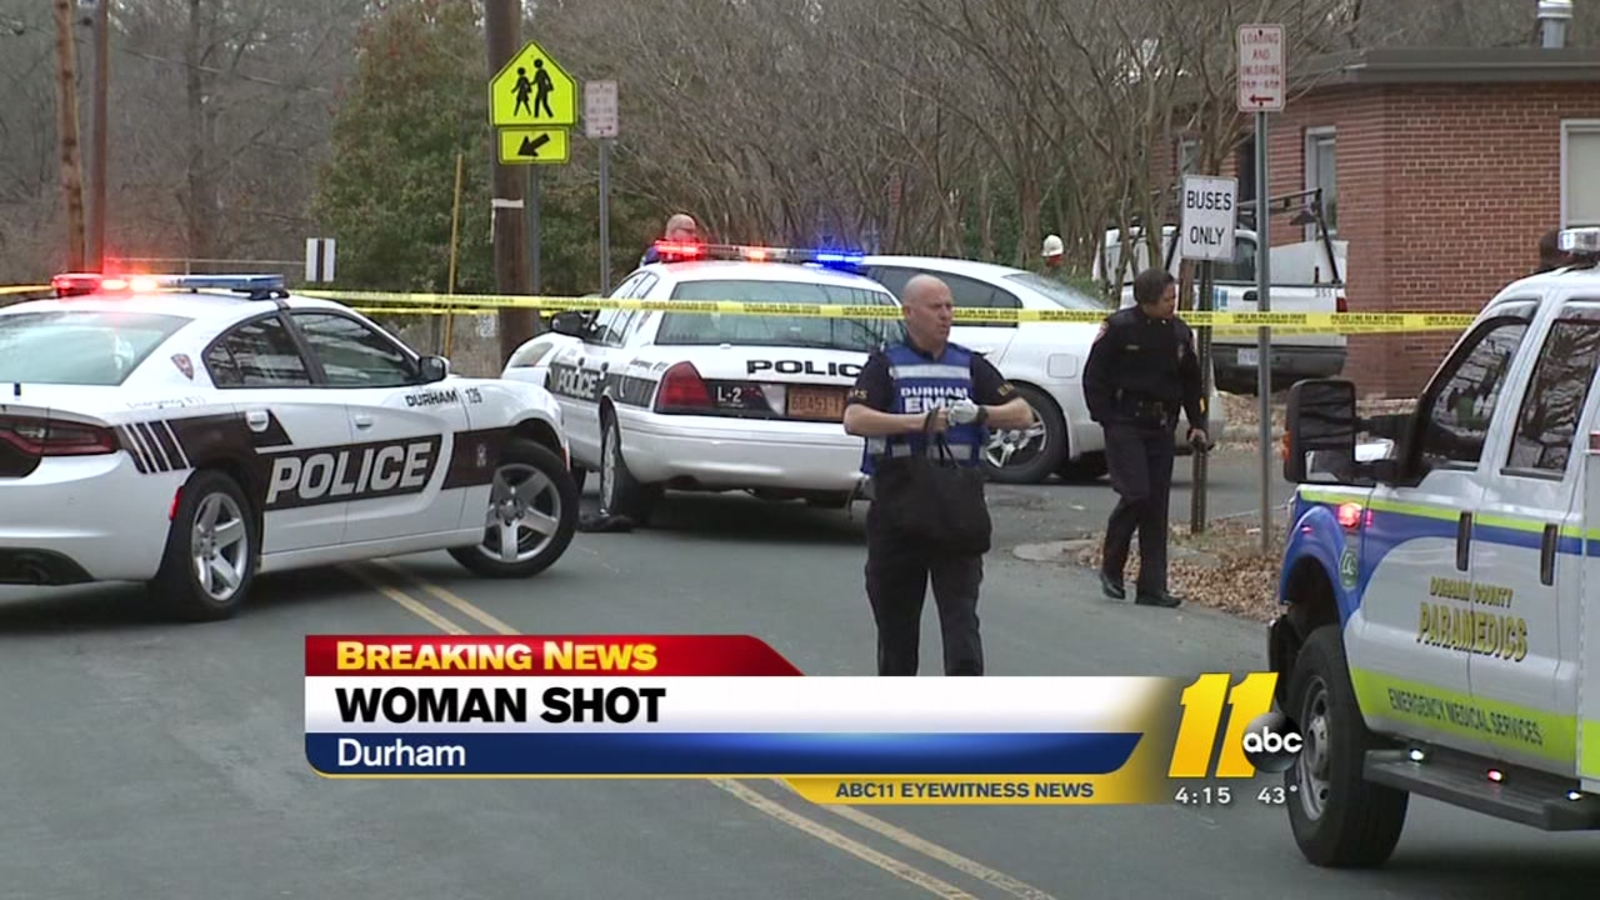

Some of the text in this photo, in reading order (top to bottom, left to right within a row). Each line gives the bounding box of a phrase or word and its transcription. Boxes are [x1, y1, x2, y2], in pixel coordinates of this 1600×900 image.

[1252, 48, 1270, 60] AND
[1187, 190, 1231, 211] BUSES
[1190, 226, 1225, 246] ONLY
[746, 359, 863, 377] POLIC
[559, 367, 599, 399] POLICE
[900, 386, 968, 398] DURHAM
[404, 389, 460, 407] DURHAM
[905, 396, 946, 413] EM
[266, 442, 432, 504] POLICE
[1473, 582, 1514, 609] COUNTY
[1417, 601, 1528, 662] PARAMEDICS
[1388, 687, 1543, 746] EMERGENCY MEDICAL SERVICES
